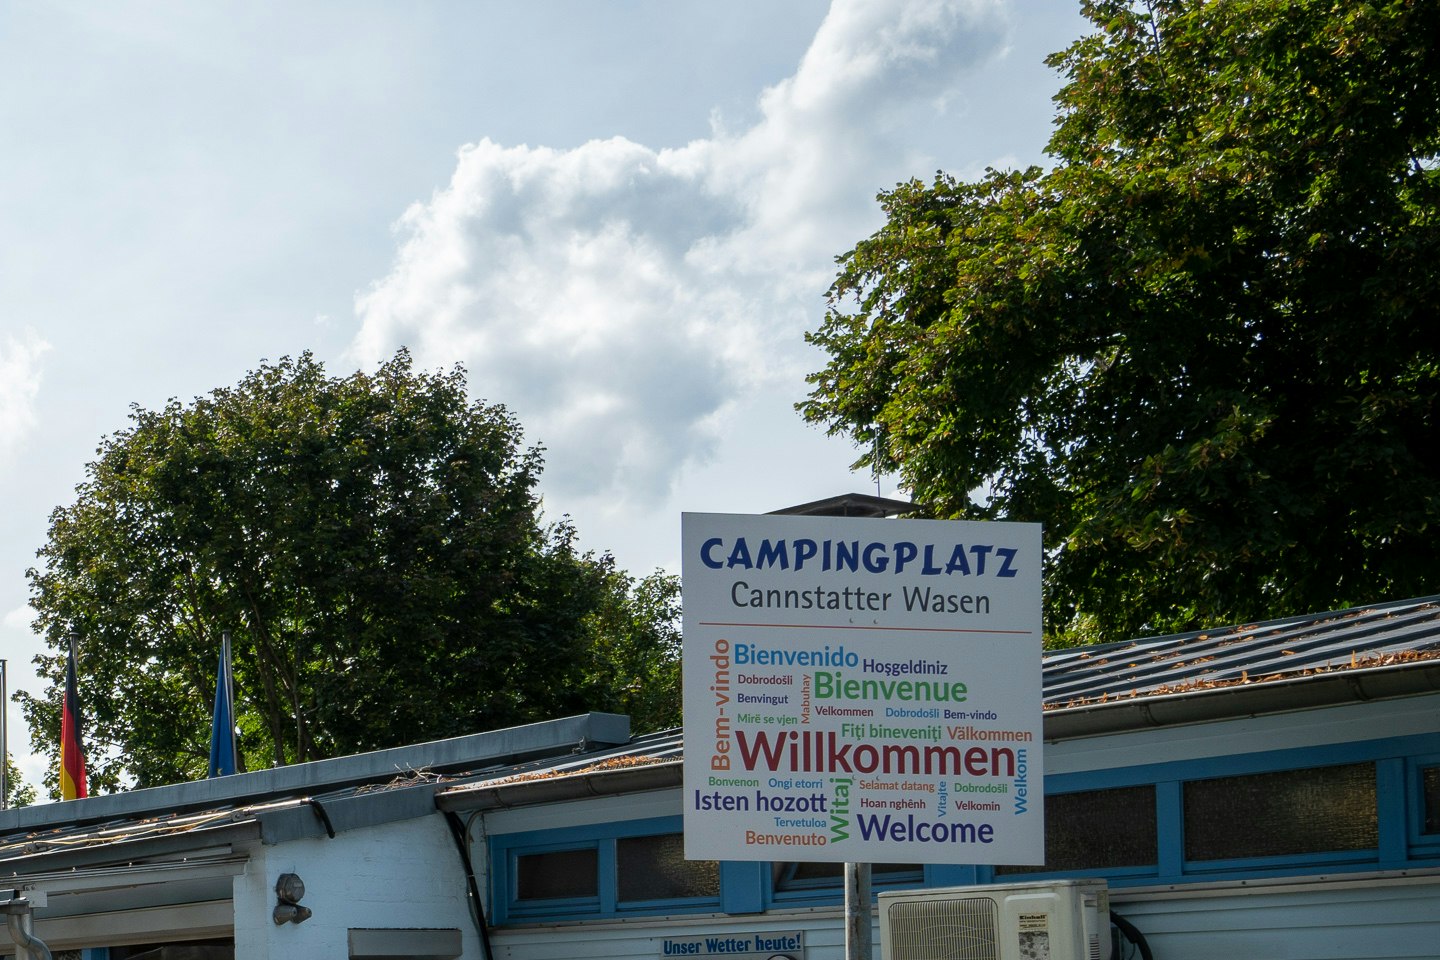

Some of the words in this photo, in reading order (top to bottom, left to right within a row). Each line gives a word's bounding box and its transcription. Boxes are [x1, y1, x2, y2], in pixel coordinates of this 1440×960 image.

[700, 537, 1018, 578] CAMPINGPLATZ
[731, 581, 892, 612] Cannstatter
[903, 586, 990, 614] Wasen
[734, 644, 858, 667] Bienvenido
[863, 659, 948, 676] Hoşgeldiniz
[738, 674, 793, 685] Dobrodošli
[814, 671, 968, 702] Bienvenue
[710, 638, 730, 771] Bem-vindo
[737, 694, 788, 705] Benvingut
[801, 674, 811, 724] Mabuhay
[737, 713, 761, 724] Mirë
[763, 715, 774, 724] se
[776, 714, 798, 726] vjen
[815, 706, 874, 717] Velkommen
[886, 708, 940, 718] Dobrodošli
[944, 710, 997, 720] Bem-vindo
[947, 726, 1032, 742] Välkommen
[735, 730, 1015, 777] Willkommen
[709, 777, 759, 787] Bonvenon
[768, 778, 793, 790] Ongi
[795, 779, 823, 788] etorri
[859, 780, 900, 790] Selamat
[902, 781, 935, 793] datang
[954, 783, 1008, 793] Dobrodošli
[1014, 748, 1028, 815] Welkom
[695, 790, 748, 811] Isten
[757, 791, 827, 812] hozott
[860, 798, 888, 808] Hoan
[889, 799, 926, 810] nghênh
[938, 781, 948, 818] Vitajte
[955, 801, 1000, 811] Velkomin
[830, 777, 853, 843] Witaj
[774, 817, 827, 828] Tervetuloa
[856, 813, 994, 843] Welcome
[746, 830, 827, 846] Benvenuto
[664, 940, 702, 954] Unser
[706, 939, 751, 953] Wetter
[755, 933, 801, 951] heute!
